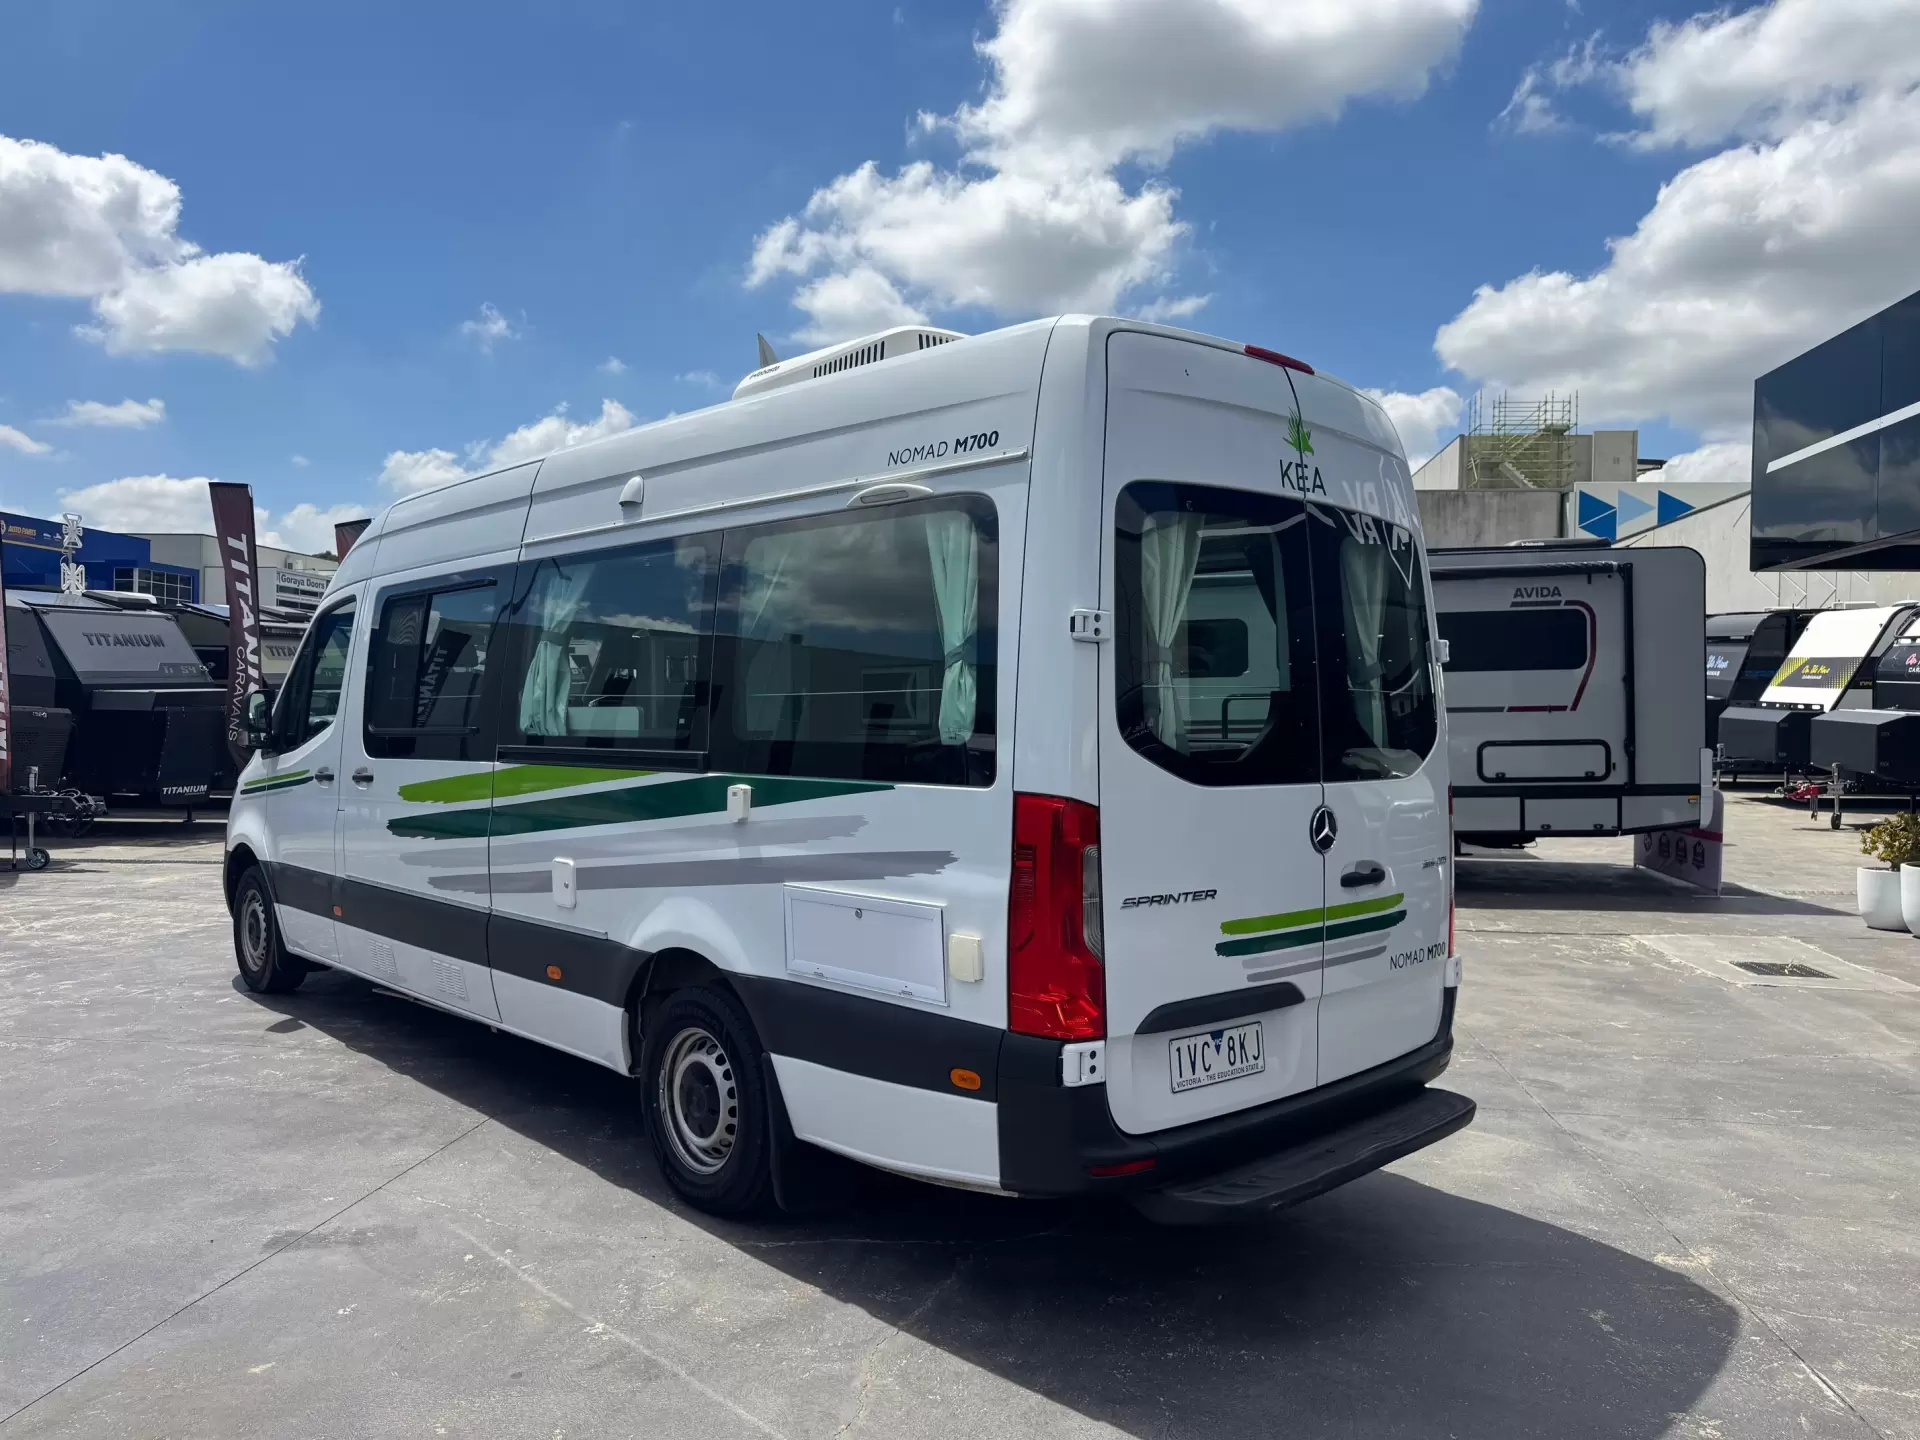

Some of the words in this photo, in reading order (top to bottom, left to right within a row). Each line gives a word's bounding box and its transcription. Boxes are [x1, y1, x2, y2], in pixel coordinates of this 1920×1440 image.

[888, 441, 948, 467] NOMAD
[953, 430, 1000, 455] M700
[1279, 459, 1327, 497] KEA
[281, 574, 305, 588] Goraya
[306, 578, 325, 590] Doors
[1513, 586, 1562, 599] AVIDA
[227, 533, 260, 694] TITANI
[82, 632, 165, 648] TITANIUM
[228, 645, 246, 741] CARAVANS
[162, 784, 208, 795] TITANIUM
[1120, 889, 1218, 910] SPRINTER
[1389, 948, 1425, 971] NOMAD
[1427, 941, 1446, 961] M700
[1176, 1041, 1212, 1079] 1VC
[1227, 1029, 1260, 1067] 8KJ
[1176, 1077, 1202, 1089] VICTORIA
[1206, 1072, 1217, 1081] THE
[1217, 1065, 1245, 1079] EDUCATION
[1245, 1062, 1259, 1072] STATE
